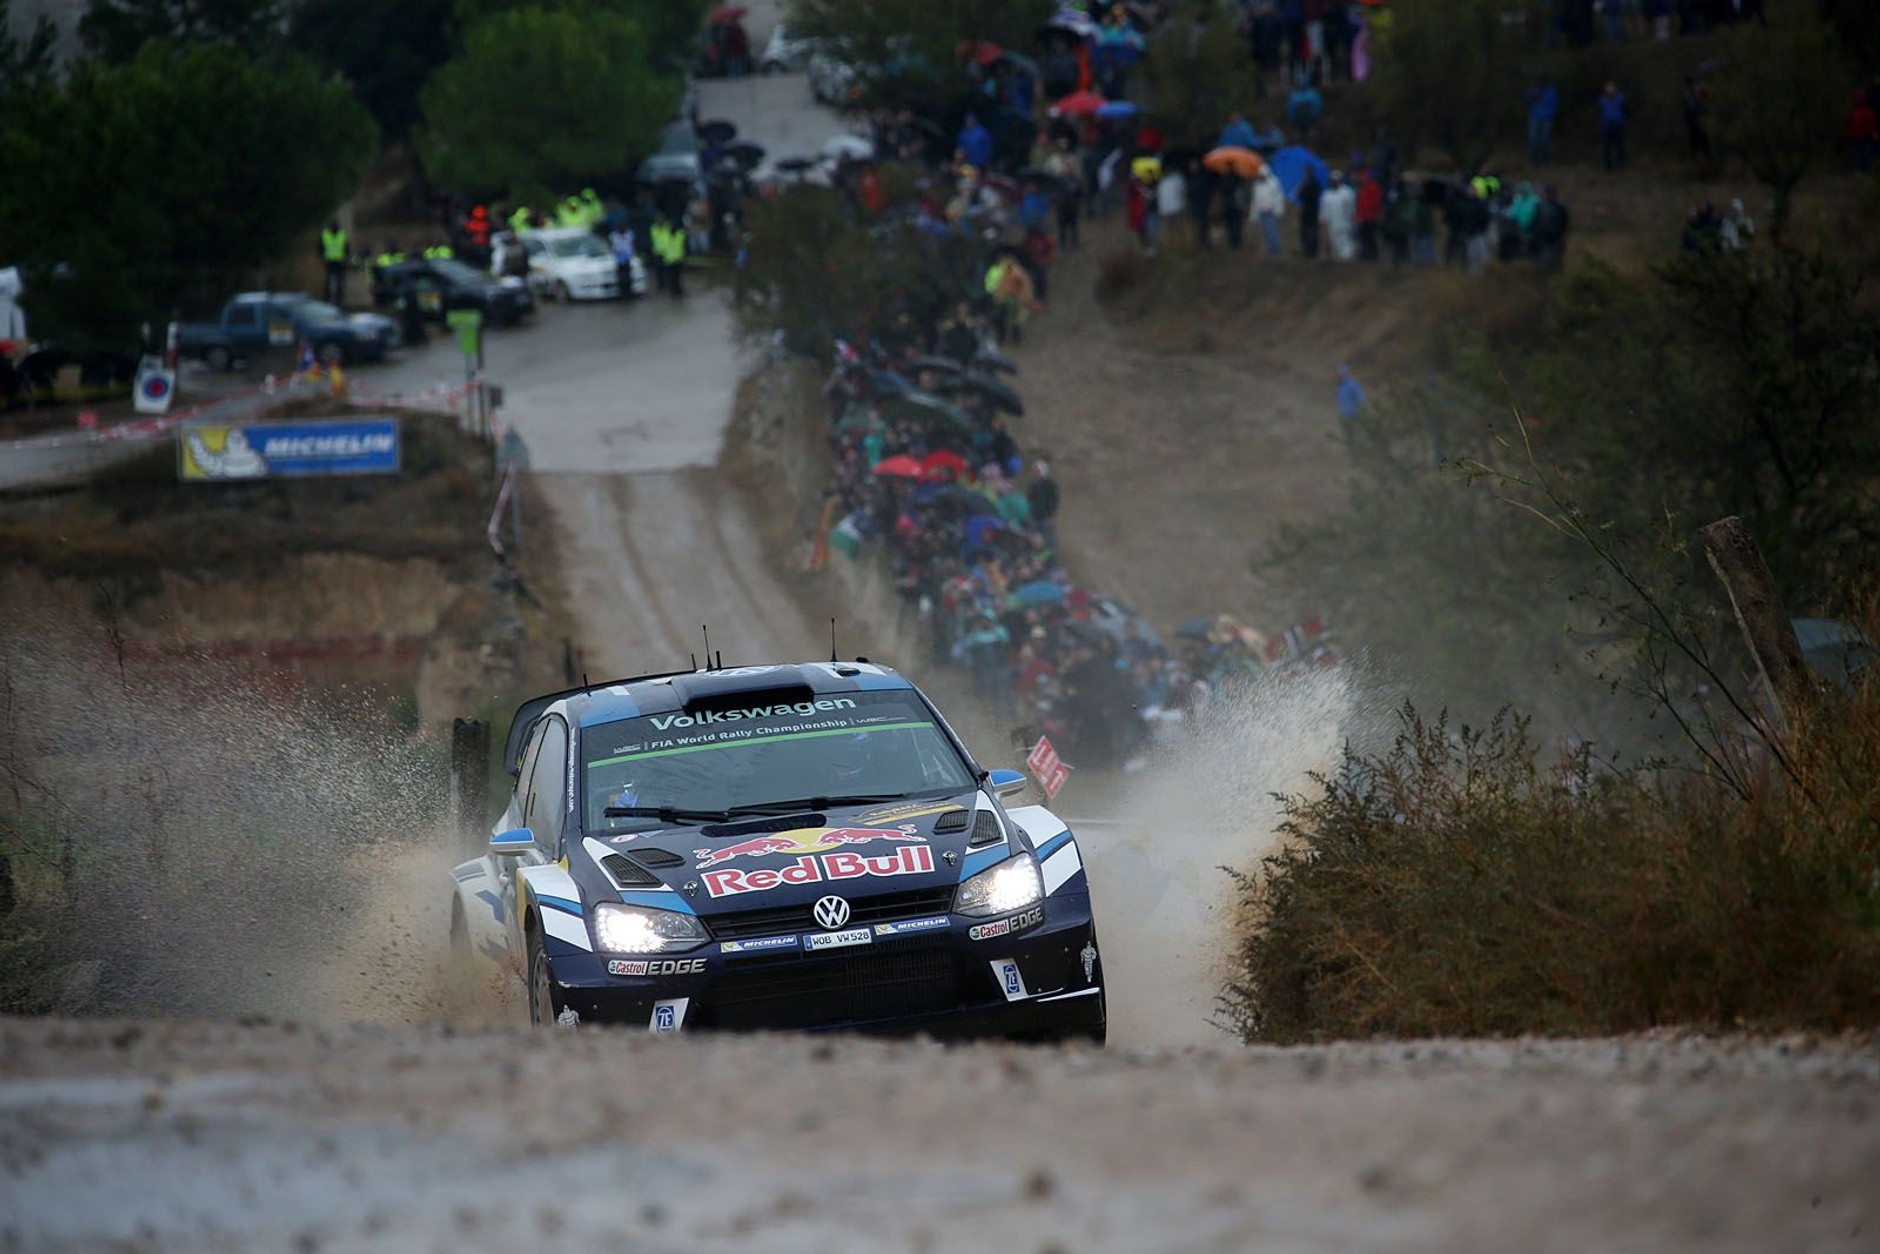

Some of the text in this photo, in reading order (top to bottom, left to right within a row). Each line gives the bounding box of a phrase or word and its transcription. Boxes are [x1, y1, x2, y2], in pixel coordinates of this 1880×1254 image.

[264, 433, 394, 456] MICHELIN
[650, 698, 856, 731] Volkswagen
[652, 739, 673, 749] FIA
[677, 733, 715, 745] World
[719, 729, 752, 741] Rally
[756, 719, 848, 736] Championship
[703, 846, 933, 897] Red Bull
[897, 917, 947, 931] MICHELIN
[979, 907, 1044, 938] Castrol EDGE
[743, 936, 795, 949] MICHELIN
[813, 936, 832, 946] WOB
[615, 957, 708, 976] Castrol EDGE
